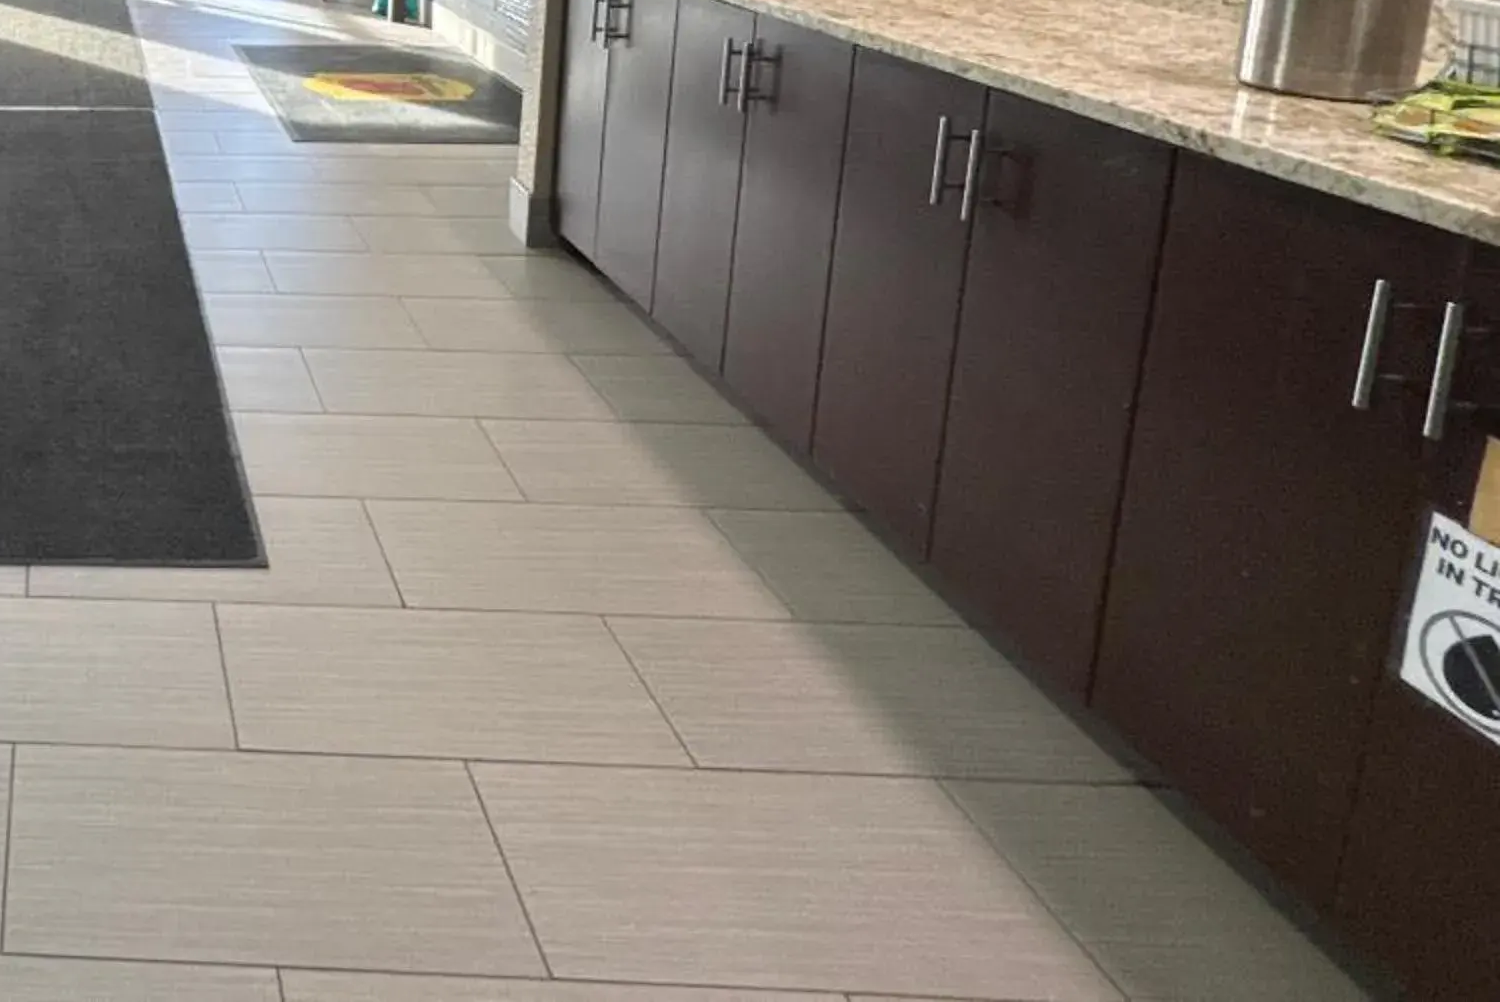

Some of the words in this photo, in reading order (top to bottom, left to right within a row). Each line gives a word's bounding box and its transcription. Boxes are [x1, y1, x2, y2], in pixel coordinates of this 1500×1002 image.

[1431, 526, 1468, 559] NO
[1474, 551, 1500, 578] LI
[1436, 557, 1464, 586] IN
